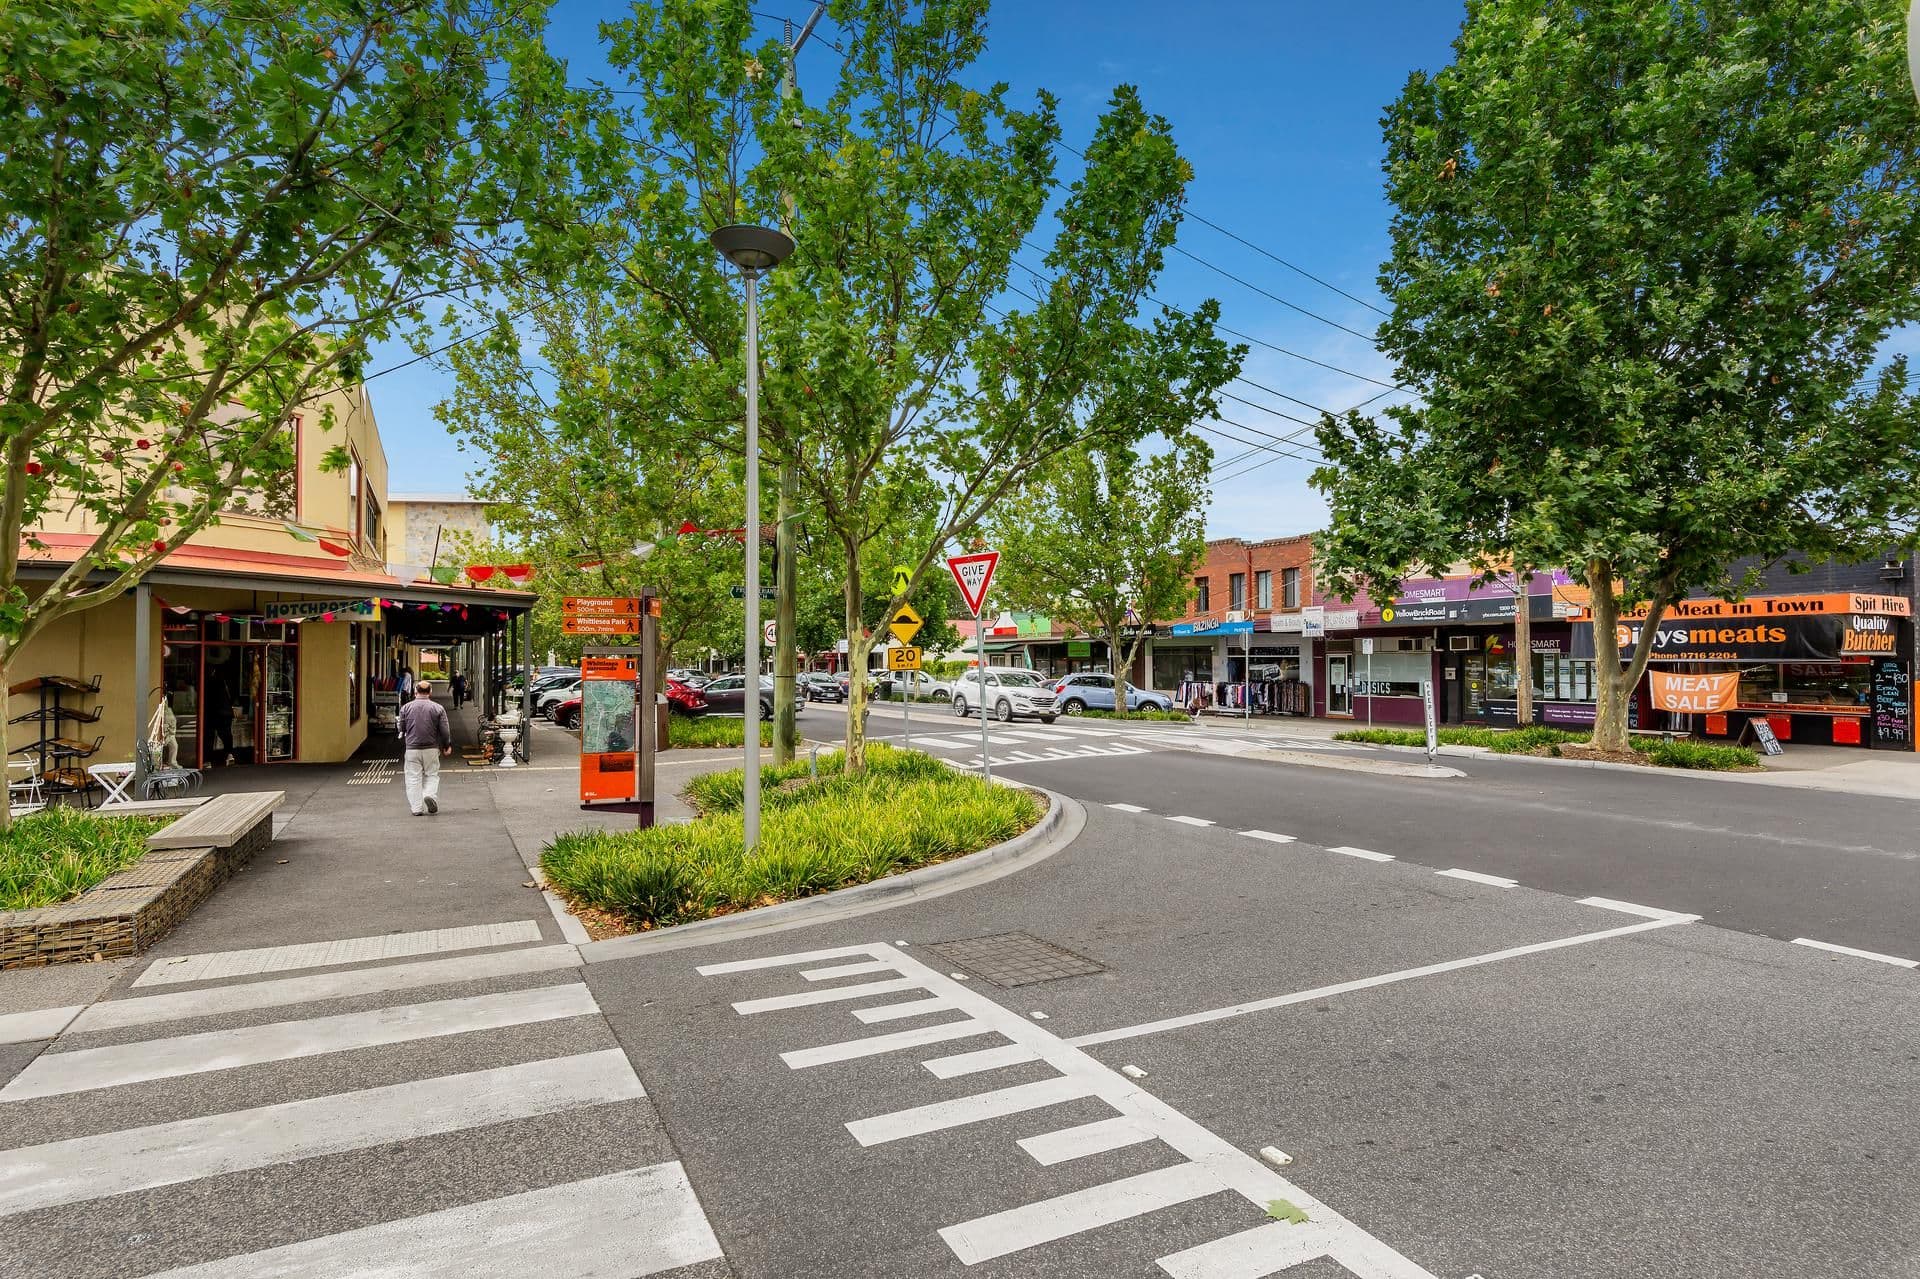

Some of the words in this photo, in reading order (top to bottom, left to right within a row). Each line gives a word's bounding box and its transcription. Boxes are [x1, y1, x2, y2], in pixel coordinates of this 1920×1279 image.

[961, 564, 984, 576] GIVE
[966, 577, 982, 586] WAY
[1404, 587, 1446, 599] OMESMART
[576, 599, 613, 607] Playground
[1674, 603, 1722, 617] Meat
[1732, 603, 1752, 614] in
[1763, 600, 1824, 613] Town
[1855, 597, 1877, 611] Spit
[1882, 597, 1905, 613] Hire
[1395, 607, 1446, 617] YellowBrickRoad
[1193, 617, 1219, 632] BAZINGA
[1852, 614, 1889, 633] Quality
[767, 628, 776, 638] 4
[1617, 624, 1786, 648] Giysmeats
[1844, 629, 1895, 651] Butcher
[895, 650, 916, 662] 20
[1649, 652, 1678, 660] Phone
[1680, 651, 1707, 660] 9716
[1708, 651, 1738, 660] 2204
[1790, 664, 1842, 676] SALE
[1361, 681, 1391, 694] BSICS
[1665, 676, 1724, 692] MEAT
[1665, 694, 1721, 711] SALE
[1878, 726, 1904, 740] $9.99
